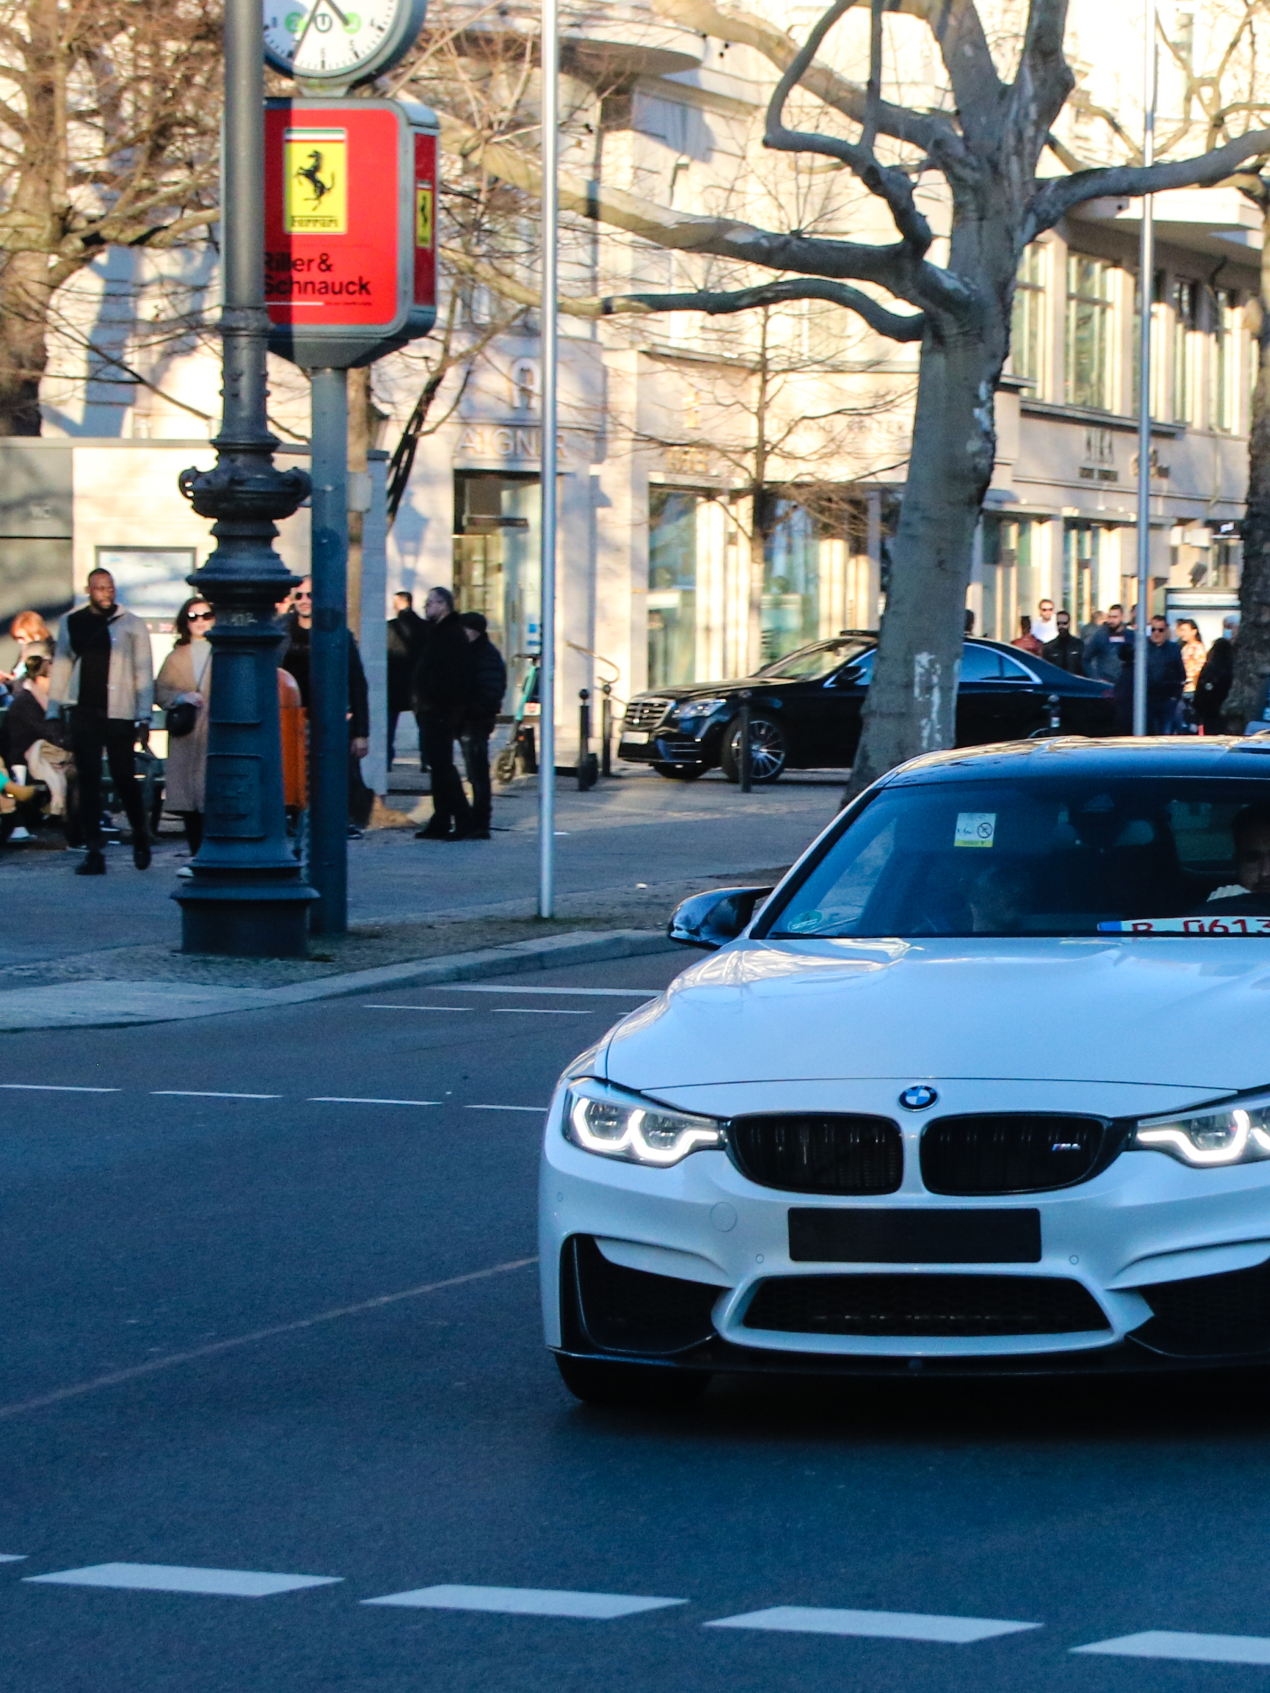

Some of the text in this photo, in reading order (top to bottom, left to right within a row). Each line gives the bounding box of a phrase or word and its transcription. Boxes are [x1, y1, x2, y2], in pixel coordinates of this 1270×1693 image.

[317, 253, 333, 272] &
[264, 276, 371, 295] Schnauck
[453, 427, 567, 459] AIGNR
